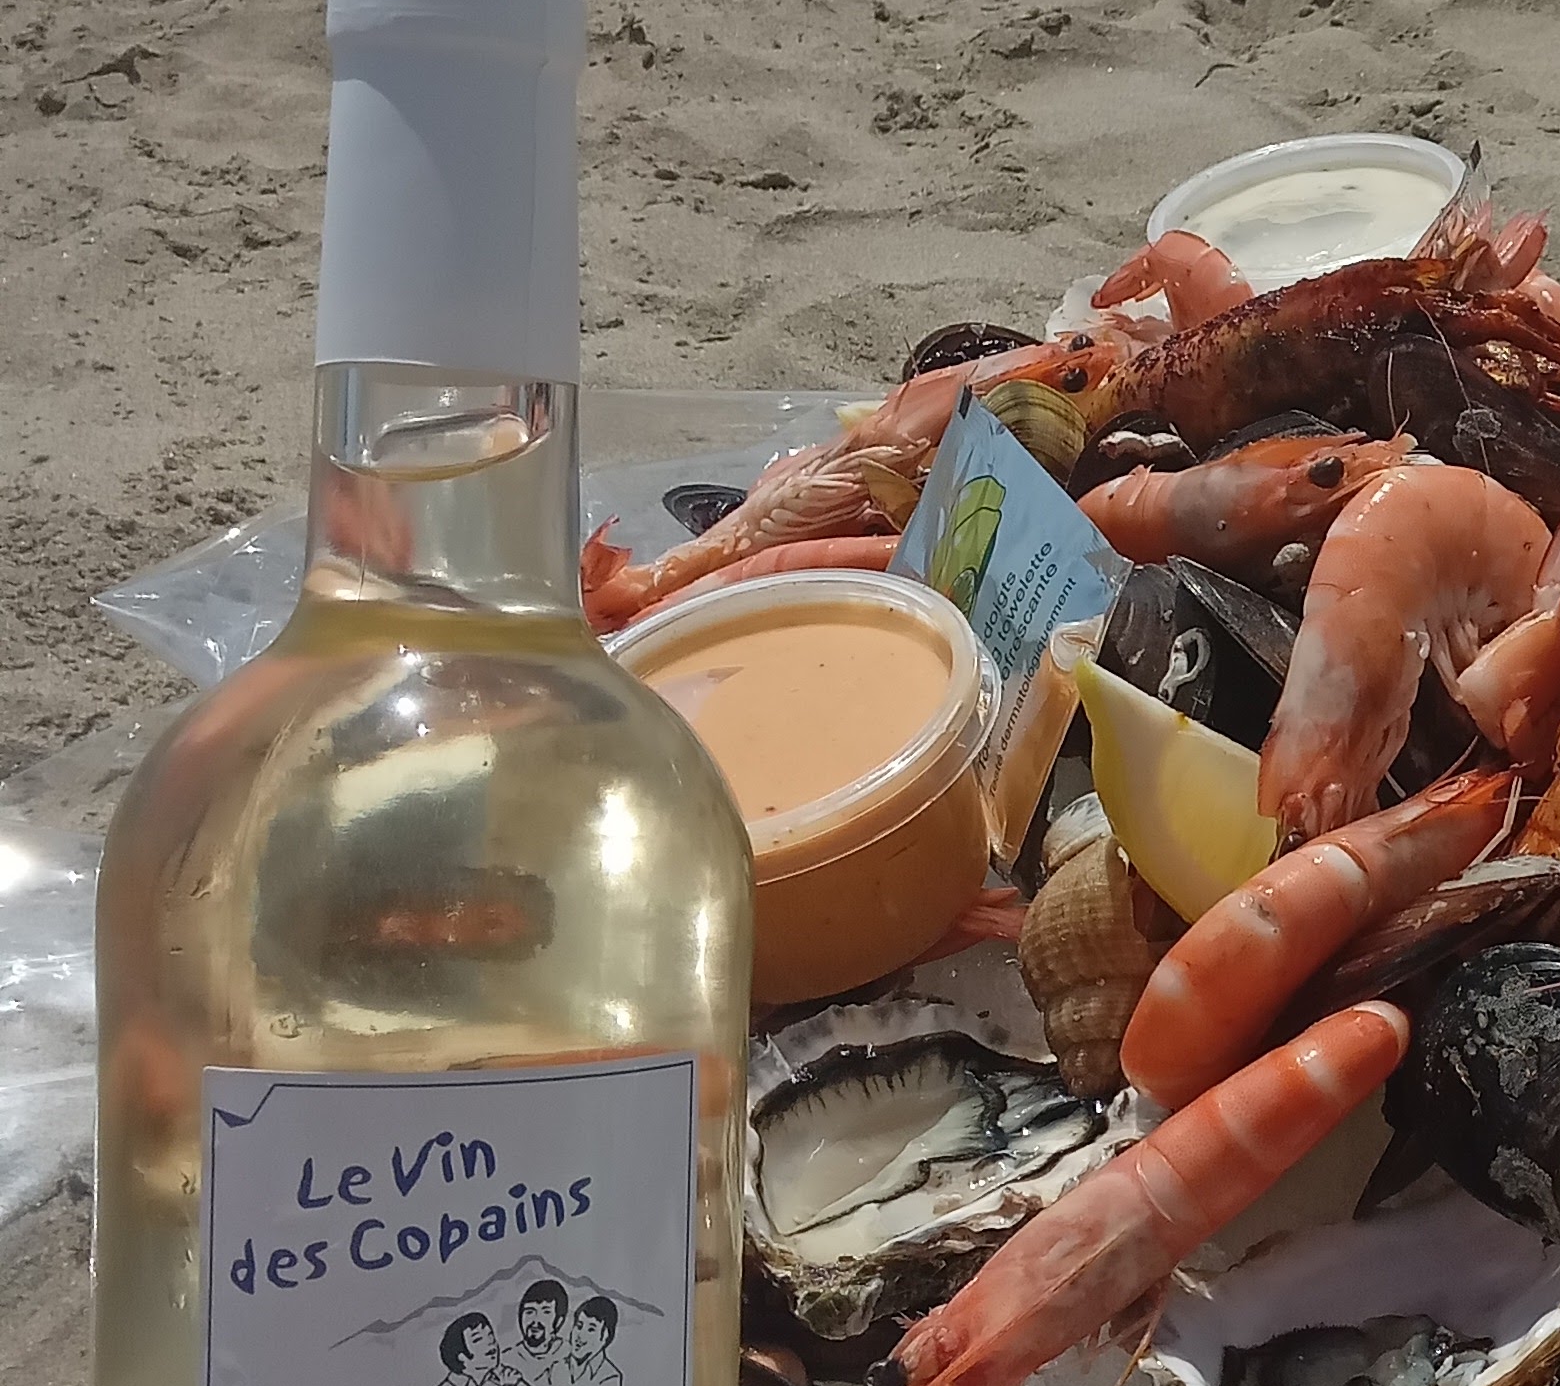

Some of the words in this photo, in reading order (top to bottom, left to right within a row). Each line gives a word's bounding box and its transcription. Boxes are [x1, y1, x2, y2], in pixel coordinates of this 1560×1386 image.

[998, 540, 1053, 639] towelette
[1001, 577, 1077, 752] dermatologiquement
[297, 1157, 372, 1210] Le
[391, 1130, 497, 1197] Vin
[230, 1237, 329, 1295] des
[350, 1176, 593, 1270] Copains
